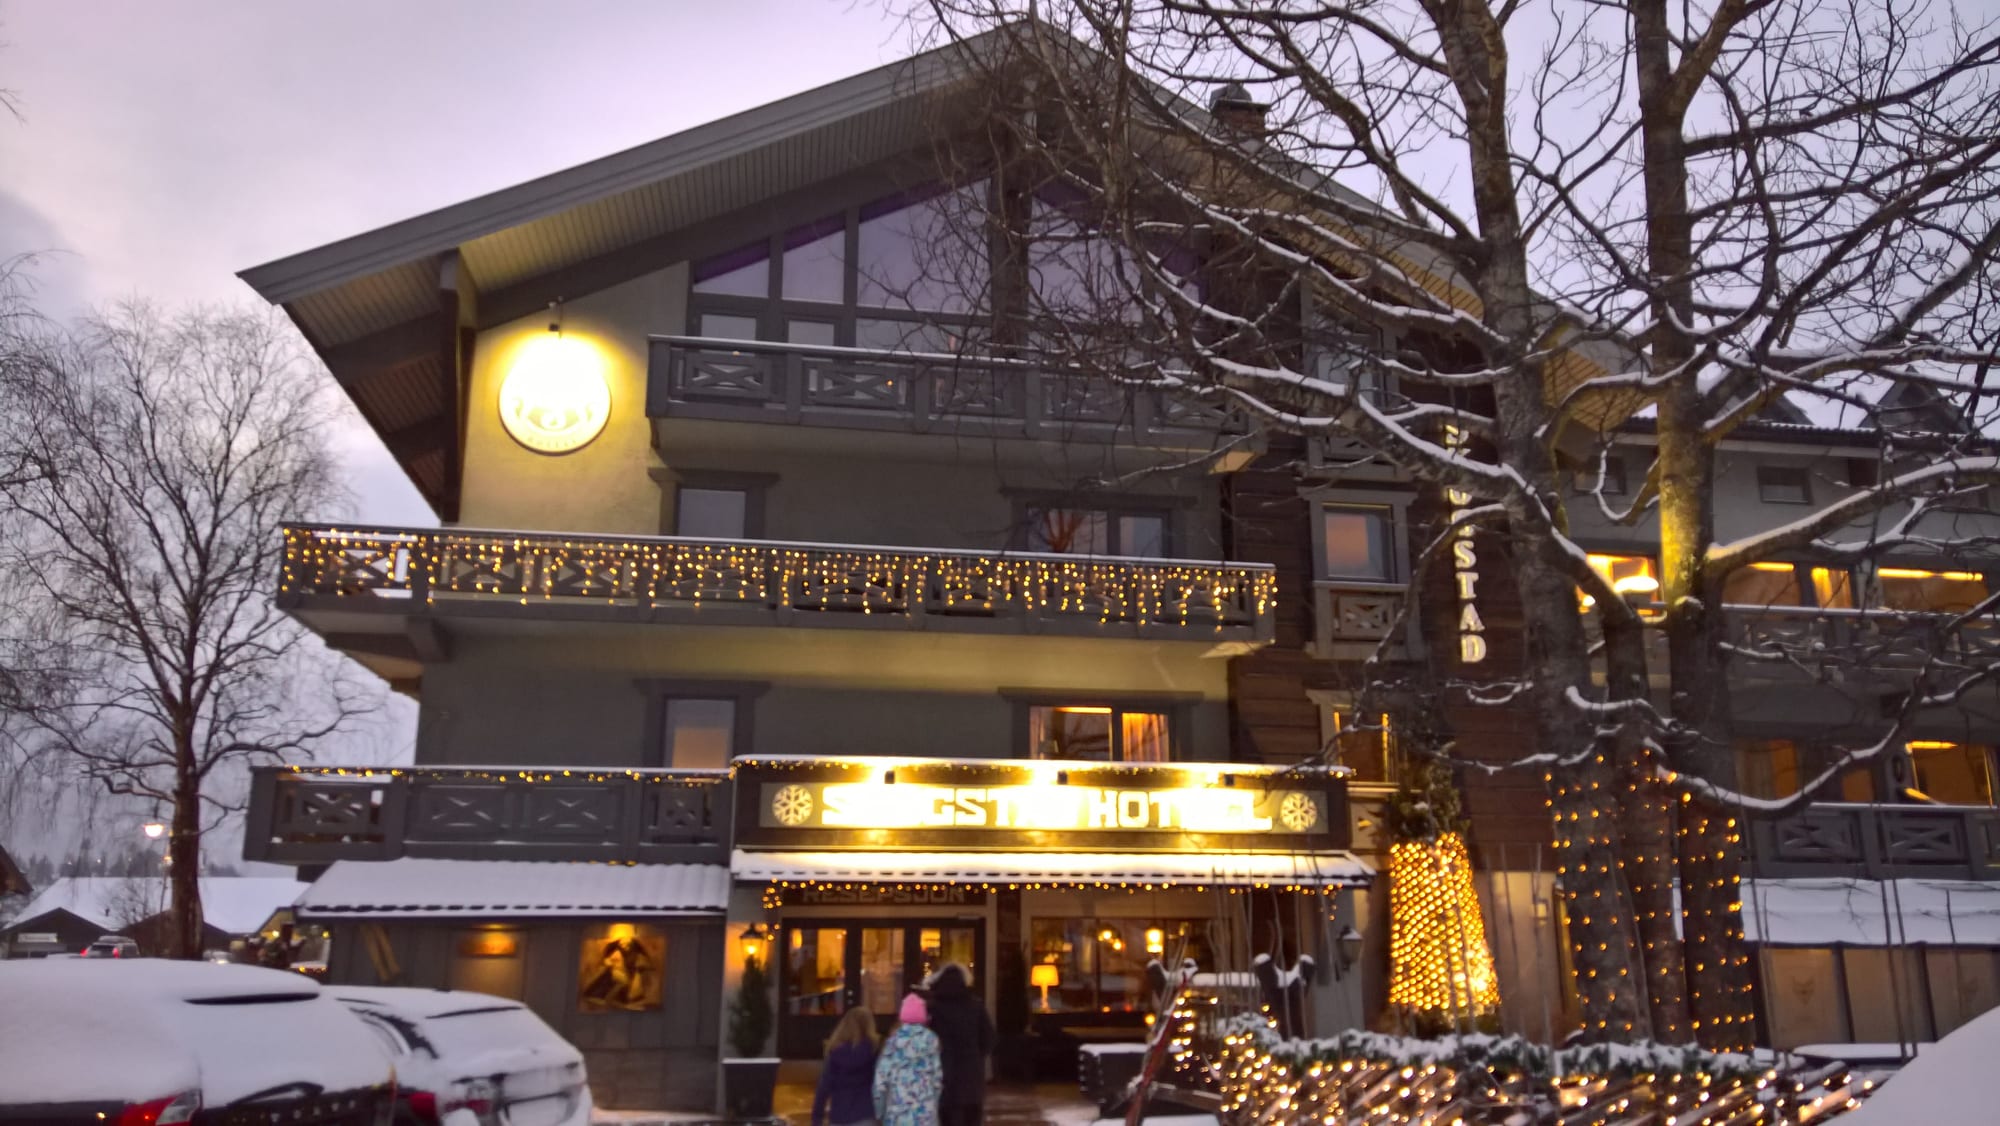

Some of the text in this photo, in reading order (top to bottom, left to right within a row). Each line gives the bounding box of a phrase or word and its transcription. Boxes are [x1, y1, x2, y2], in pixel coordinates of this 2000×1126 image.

[822, 784, 1273, 832] SGST HOTL
[802, 886, 965, 903] RESEPSJON
